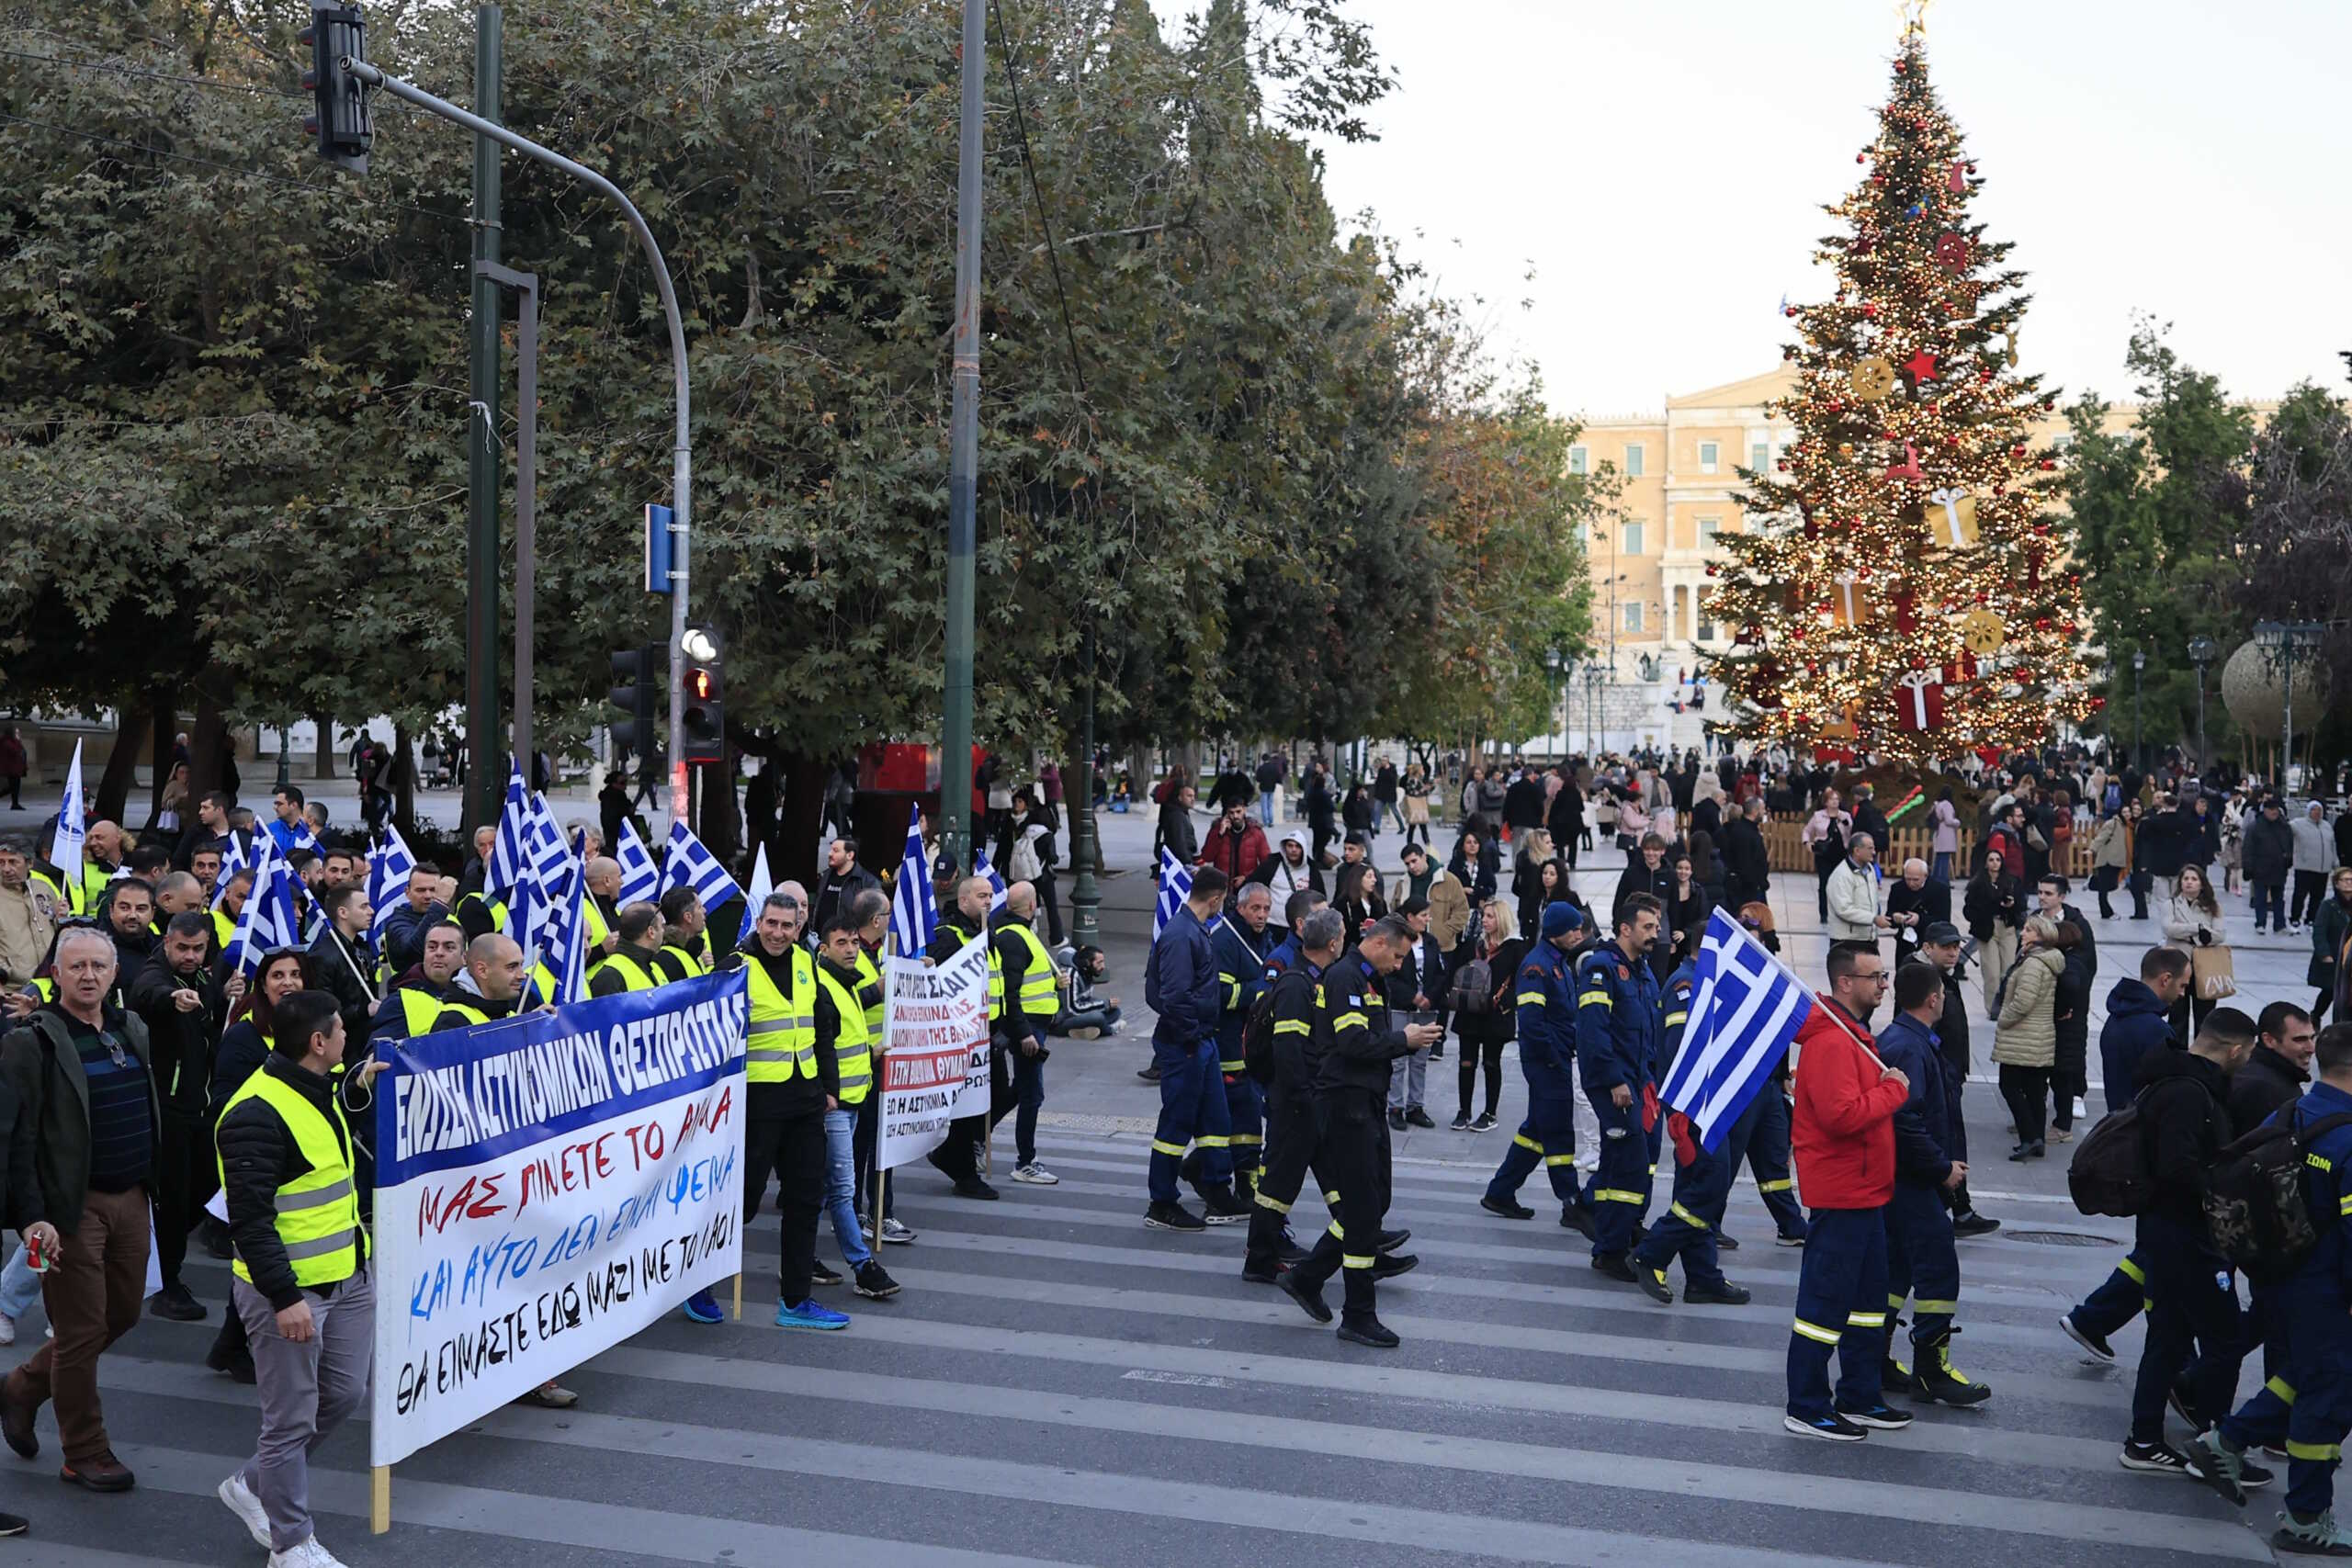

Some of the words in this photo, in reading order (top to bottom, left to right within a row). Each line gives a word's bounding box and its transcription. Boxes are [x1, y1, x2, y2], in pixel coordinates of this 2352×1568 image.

[395, 1065, 480, 1161] ΕΝΩΣΗ
[472, 1030, 613, 1140] ΑΣΤΥΝΟΜΙΚΩΝ
[609, 992, 747, 1096] ΘΕΣΠΡΩΤΙΑΣ
[898, 1097, 907, 1114] Η
[419, 1172, 507, 1245] ΜΑΣ
[514, 1132, 616, 1222] ΠΙΝΕΤΕ
[625, 1121, 664, 1171] ΤΟ
[673, 1086, 732, 1153] ΑΙΜΑ
[396, 1349, 428, 1416] ΘΑ
[438, 1303, 531, 1393] ΕΙΜΑΣΤΕ
[537, 1281, 582, 1341] ΕΔΩ
[587, 1254, 634, 1322] ΜΑΖΙ
[642, 1239, 674, 1295] ΜΕ
[409, 1258, 453, 1343] ΚΑΙ
[461, 1232, 538, 1307] ΑΥΤΟ
[539, 1209, 605, 1270] ΔΕΝ
[607, 1177, 662, 1242] ΕΙΝΑΙ
